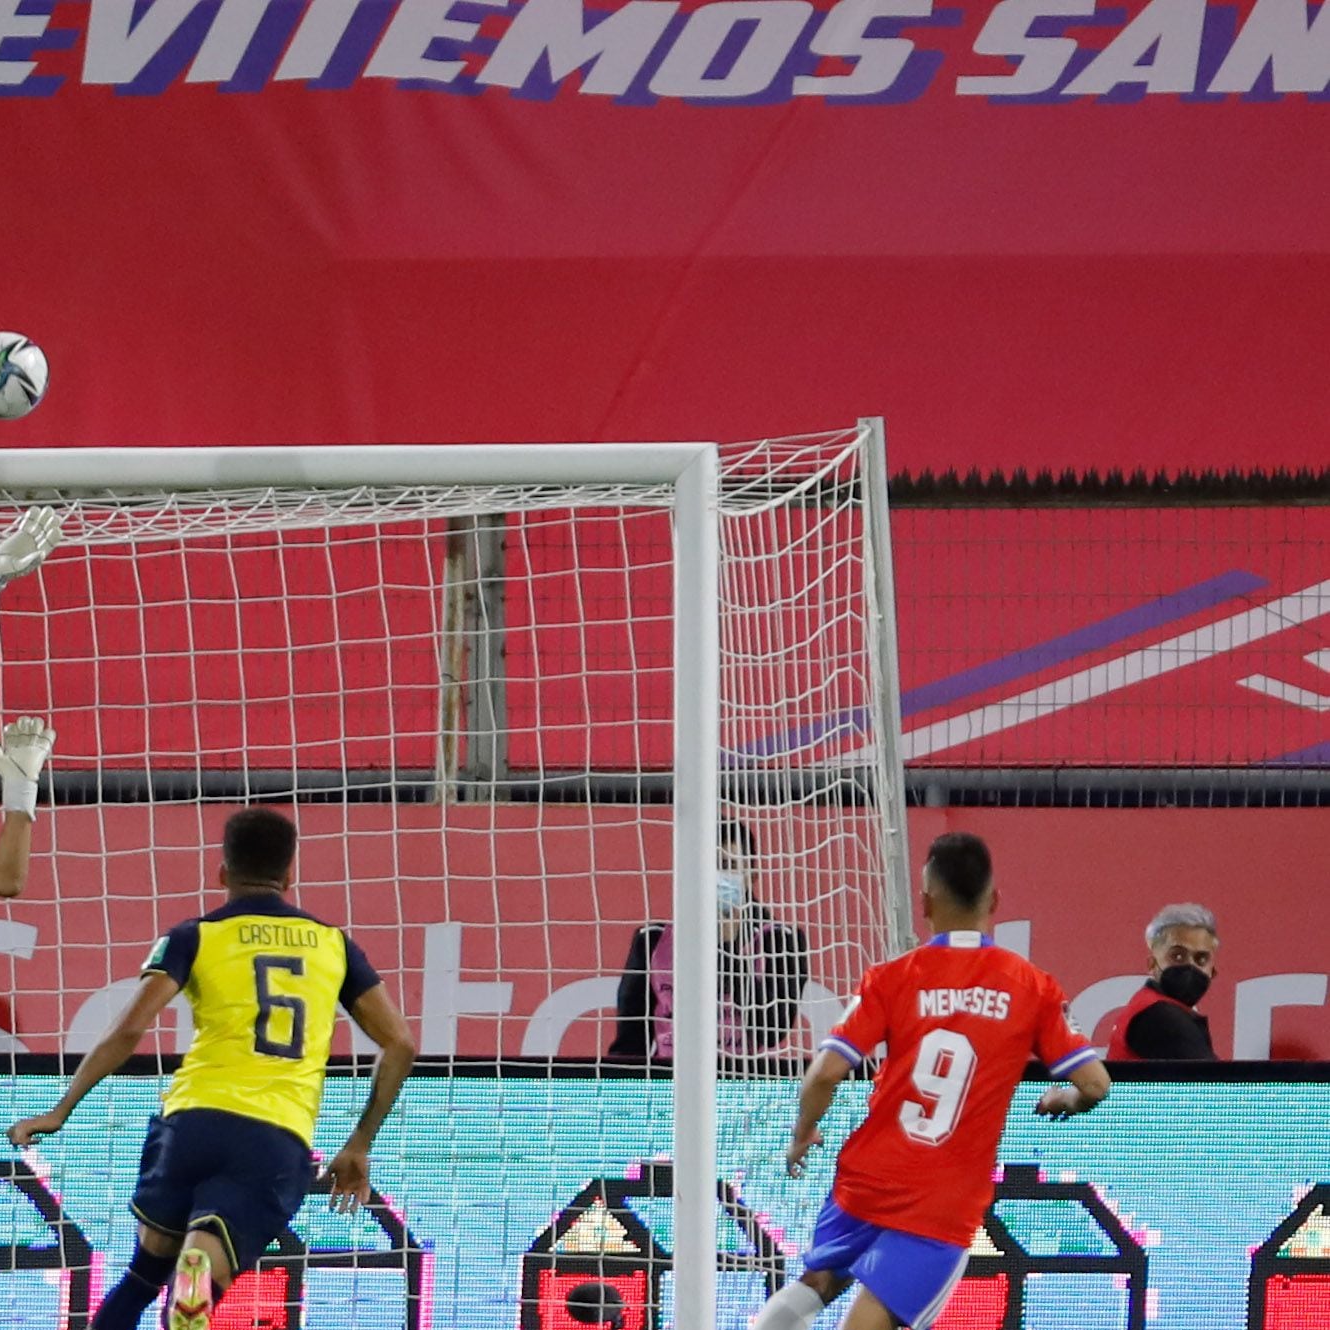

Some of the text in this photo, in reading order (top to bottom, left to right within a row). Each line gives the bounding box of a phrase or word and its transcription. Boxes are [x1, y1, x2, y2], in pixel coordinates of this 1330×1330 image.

[239, 924, 319, 949] CASTILLO
[254, 955, 306, 1060] 6
[919, 986, 1012, 1021] MENESES
[898, 1027, 979, 1147] 9
